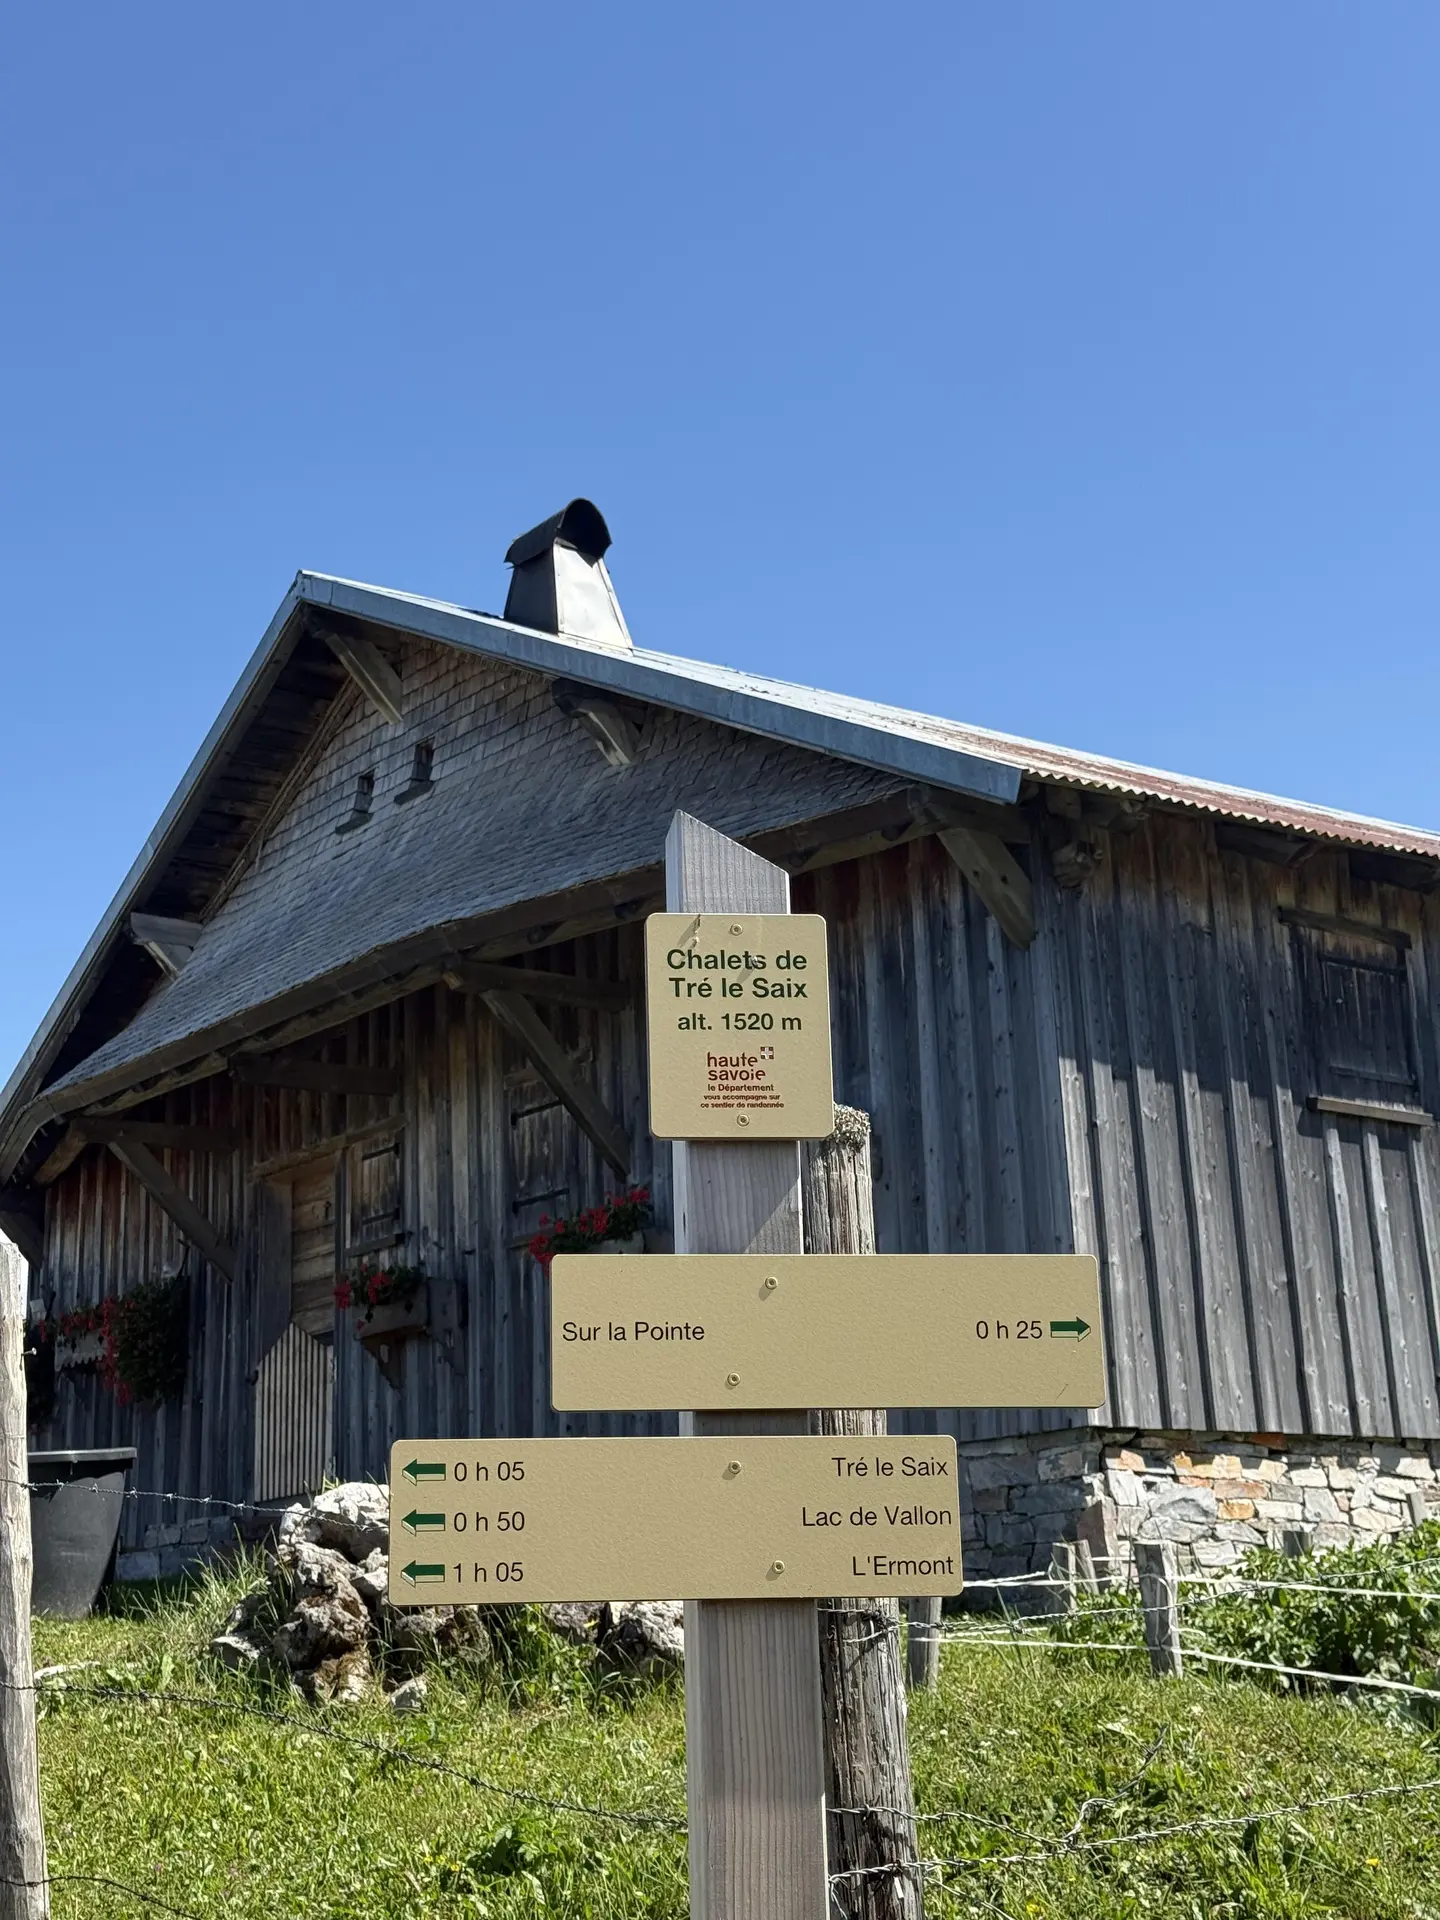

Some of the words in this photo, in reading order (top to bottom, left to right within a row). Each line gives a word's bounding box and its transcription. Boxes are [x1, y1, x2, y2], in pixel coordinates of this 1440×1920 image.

[667, 949, 767, 970] Chalets
[776, 950, 807, 970] de
[669, 978, 712, 998] Tré
[722, 978, 743, 998] le
[752, 978, 808, 998] Saix
[678, 1013, 712, 1030] alt.
[721, 1013, 774, 1030] 1520
[782, 1017, 802, 1030] m
[707, 1052, 758, 1067] haute
[708, 1068, 766, 1081] savoie
[718, 1084, 774, 1092] Département
[562, 1322, 601, 1341] Sur
[608, 1322, 627, 1341] la
[634, 1322, 705, 1341] Pointe
[975, 1321, 989, 1340] 0
[996, 1320, 1009, 1339] h
[1016, 1320, 1043, 1339] 25
[454, 1462, 467, 1482] 0
[476, 1461, 489, 1481] h
[497, 1461, 525, 1482] 05
[832, 1457, 868, 1477] Tré
[876, 1457, 893, 1477] le
[901, 1457, 948, 1477] Saix
[454, 1512, 467, 1532] 0
[476, 1512, 489, 1532] h
[497, 1511, 525, 1532] 50
[802, 1507, 842, 1527] Lac
[850, 1507, 877, 1527] de
[883, 1506, 952, 1526] Vallon
[452, 1563, 463, 1582] 1
[474, 1562, 487, 1582] h
[495, 1562, 524, 1582] 05
[852, 1556, 954, 1576] L'Ermont
